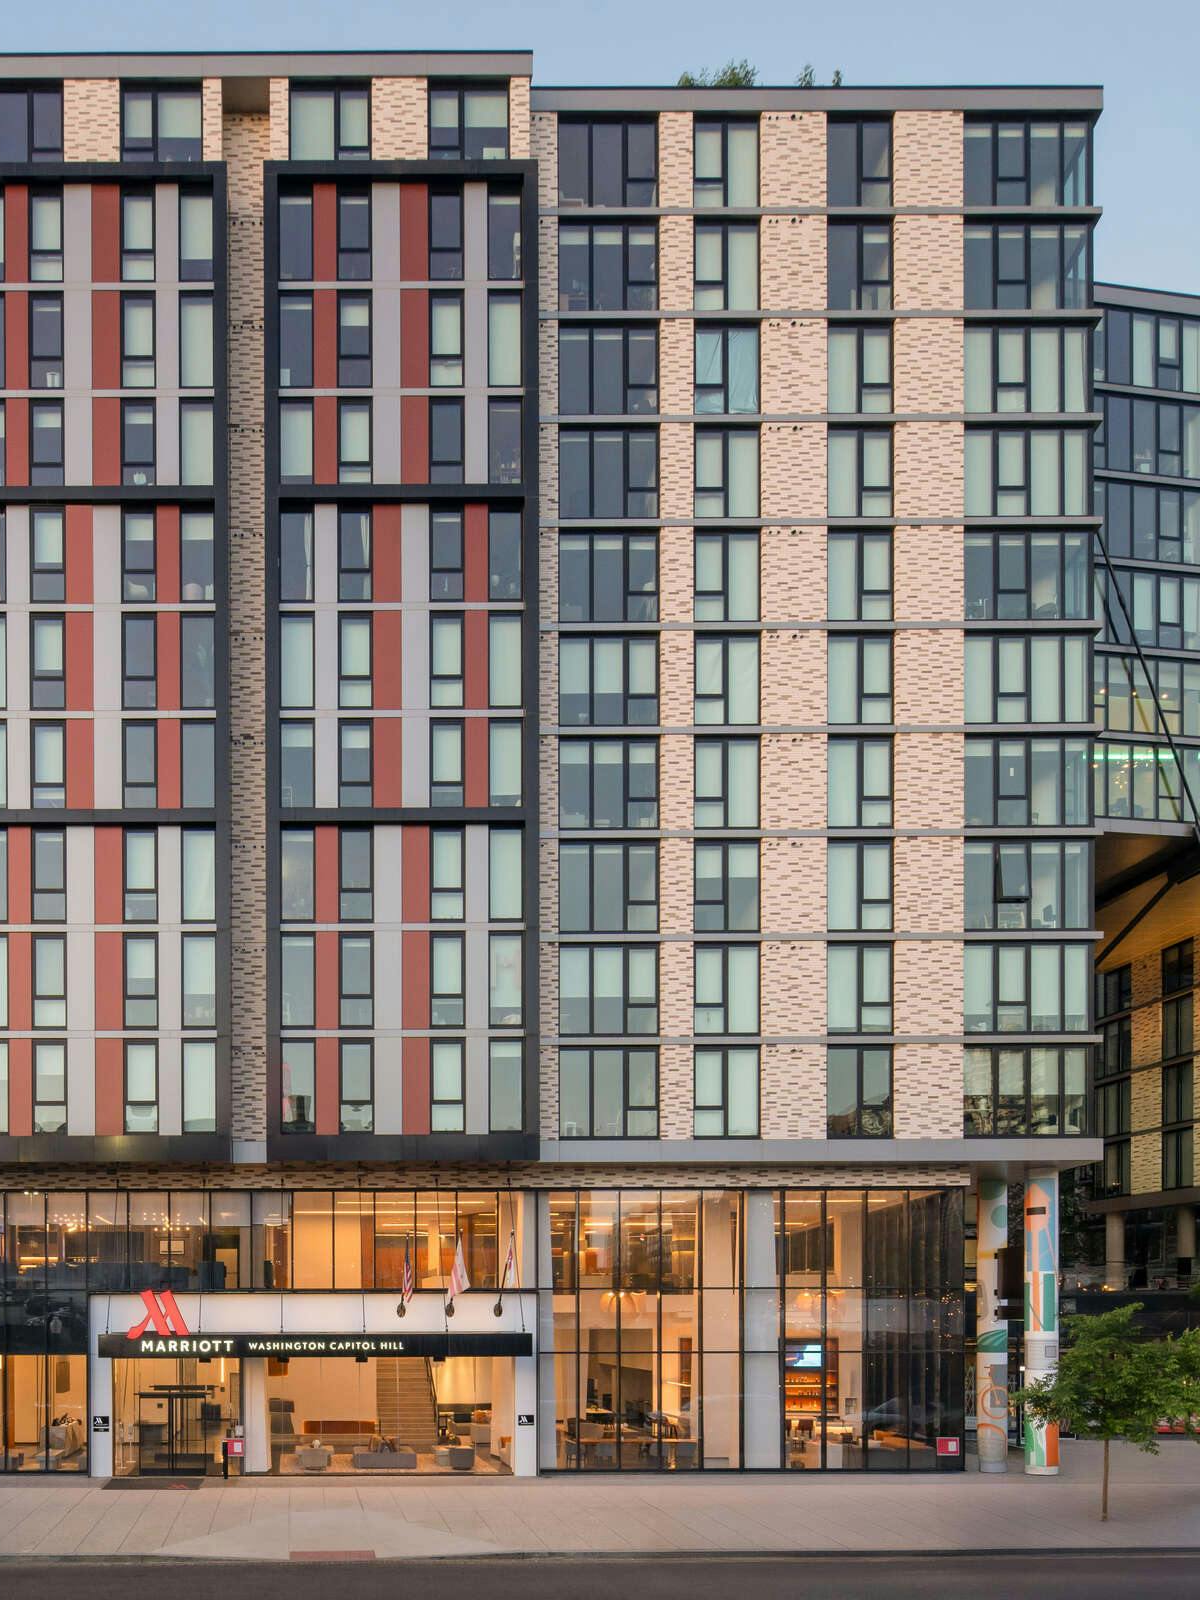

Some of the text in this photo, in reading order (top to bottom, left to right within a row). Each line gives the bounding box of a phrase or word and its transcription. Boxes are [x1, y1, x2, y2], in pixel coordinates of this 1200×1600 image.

[141, 1340, 405, 1353] MARRIOTT WASHINGTON CAPITOL HILL
